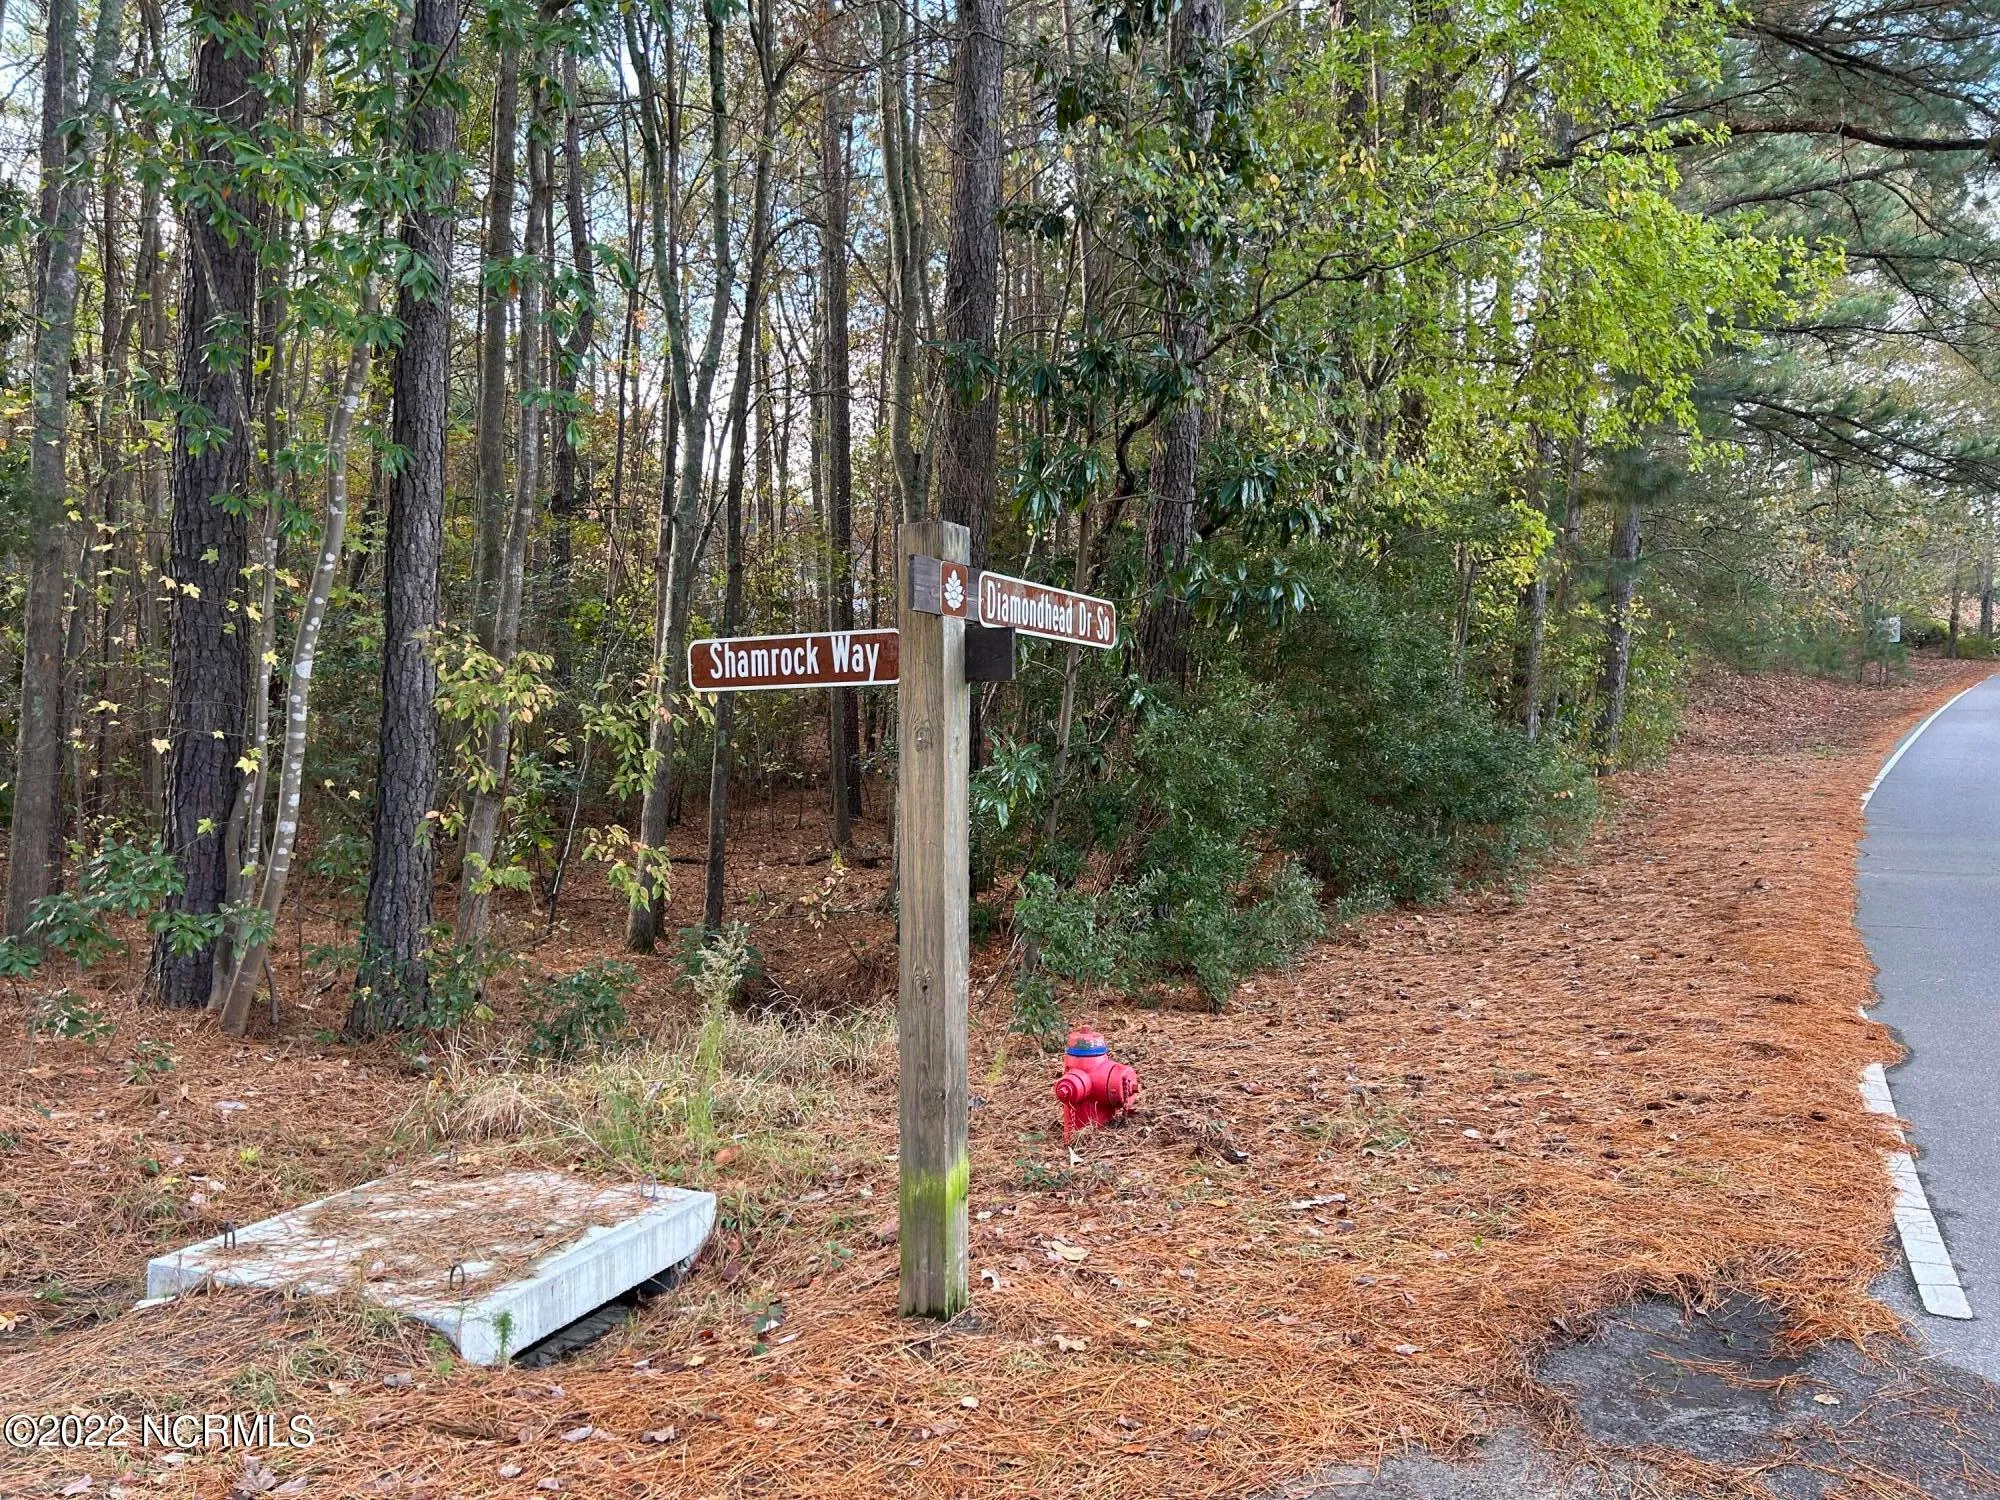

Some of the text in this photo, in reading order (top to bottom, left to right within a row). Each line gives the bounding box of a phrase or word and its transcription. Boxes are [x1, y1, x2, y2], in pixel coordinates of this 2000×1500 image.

[987, 580, 1110, 641] Diamondhead Dr So
[709, 635, 880, 681] Shamrock Way
